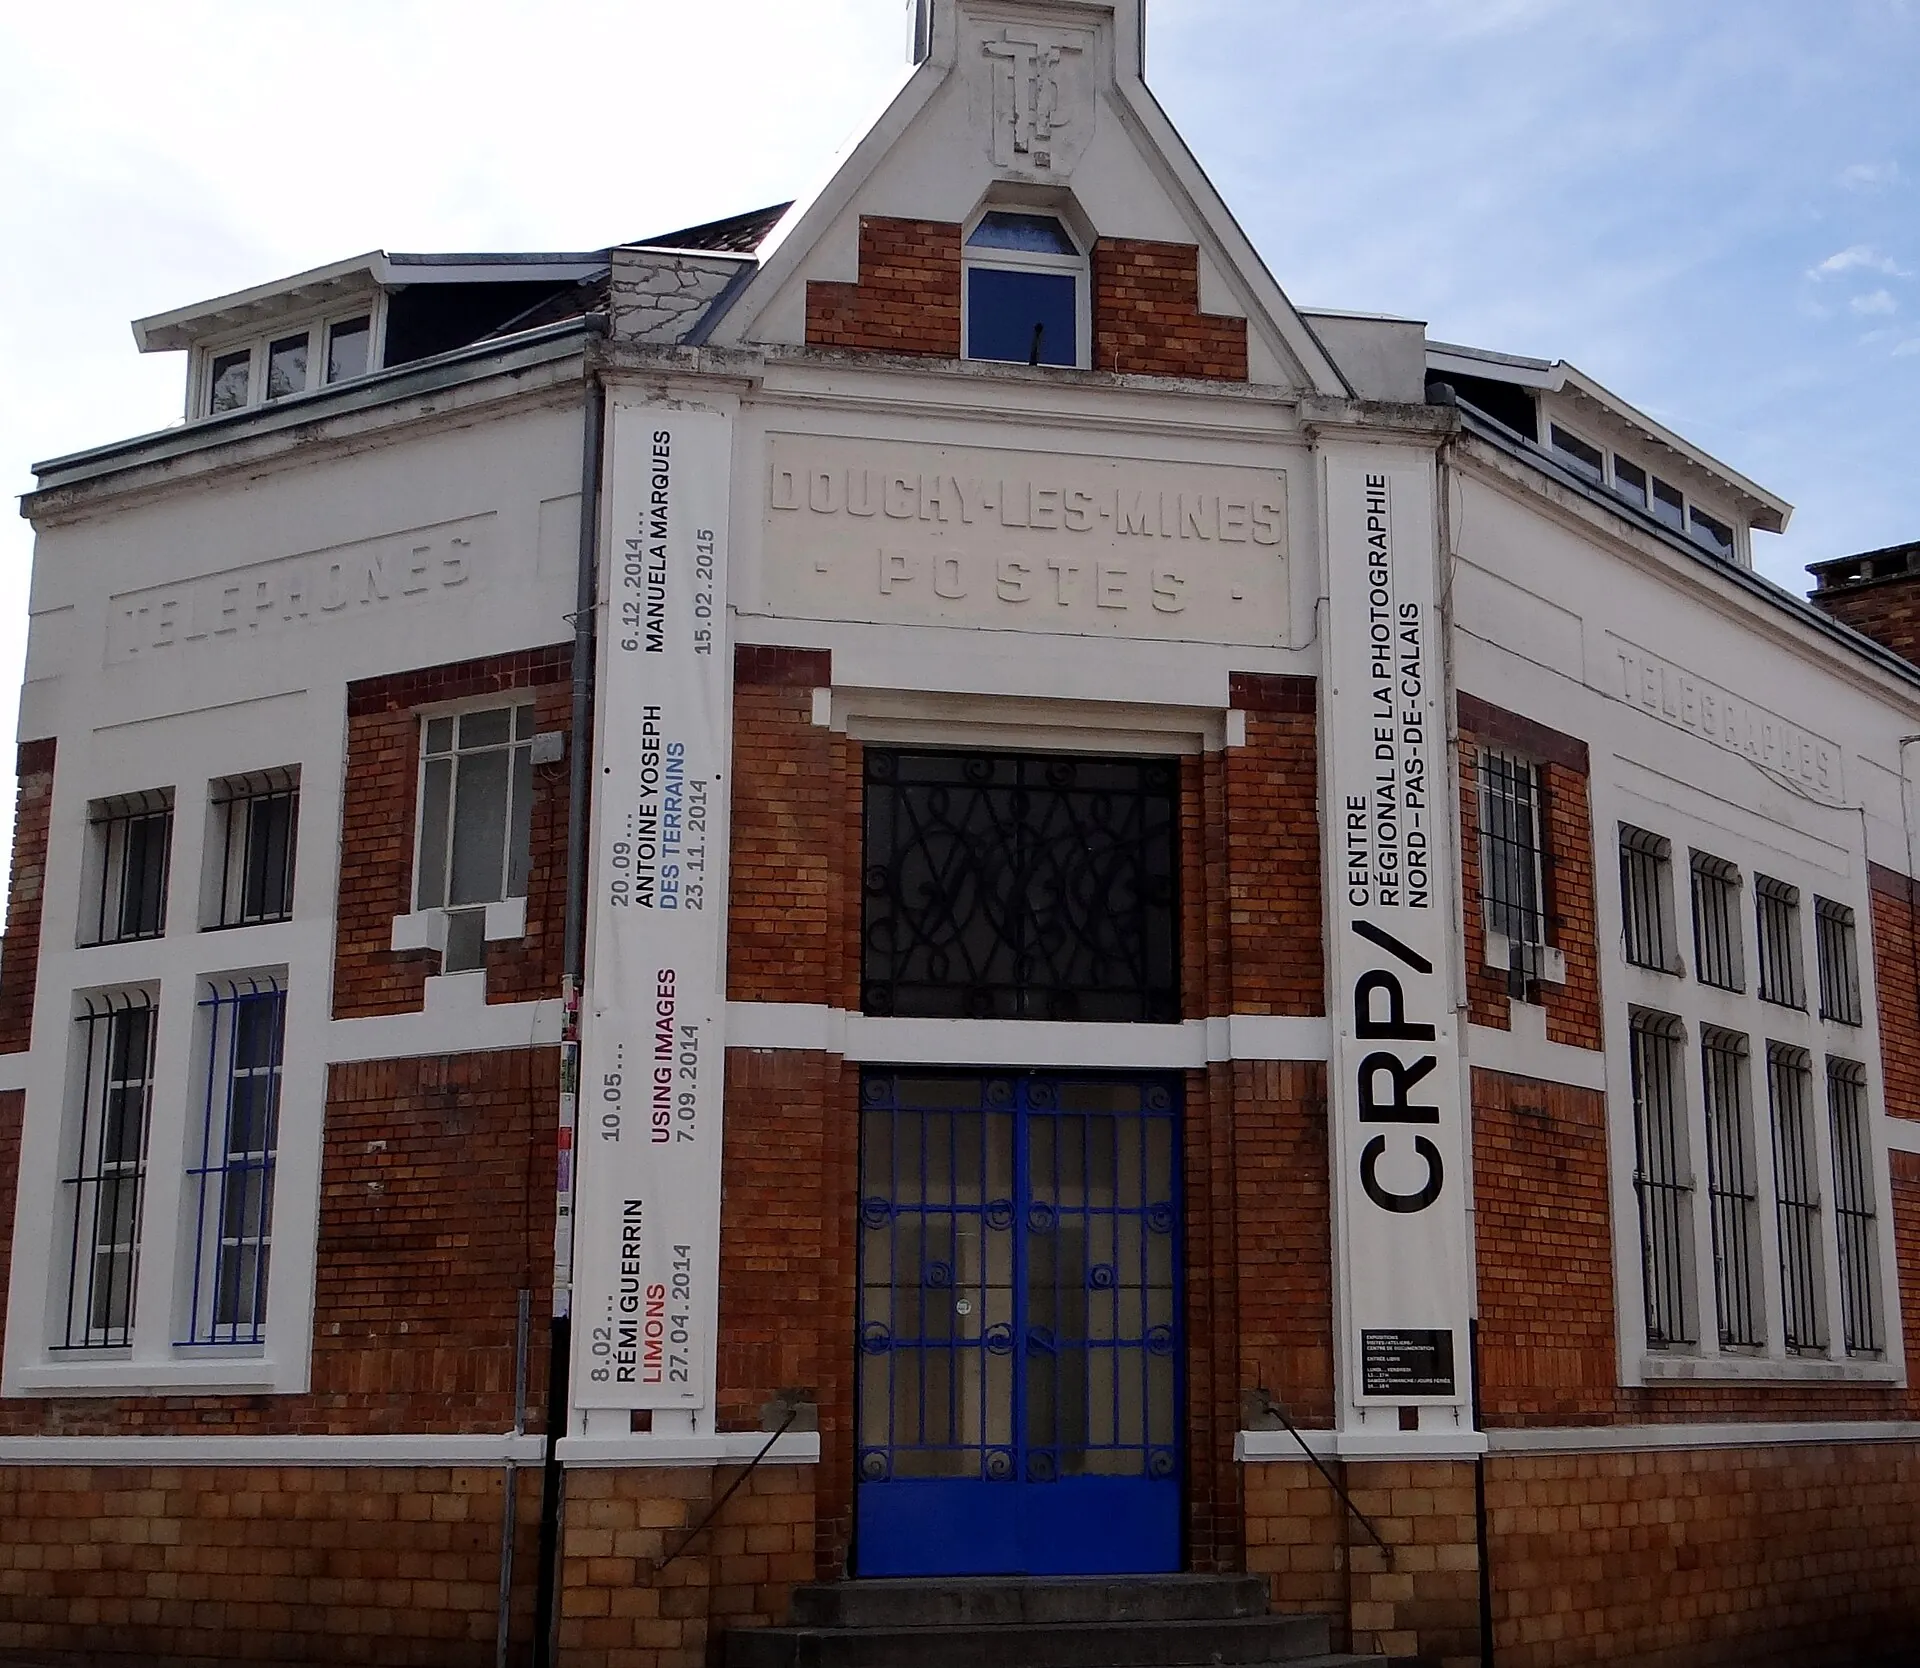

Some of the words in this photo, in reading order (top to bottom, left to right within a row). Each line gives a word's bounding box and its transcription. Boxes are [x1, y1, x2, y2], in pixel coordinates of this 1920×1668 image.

[650, 430, 671, 539] MARQUES
[124, 534, 472, 653] TELEPHONES
[646, 544, 667, 653] MANUELA
[694, 529, 714, 655] 15.02.2015
[879, 548, 1185, 614] POSTES
[1366, 474, 1392, 679] PHOTOGRAPHIE
[640, 705, 661, 798] YOSEPH
[1372, 686, 1393, 719] LA
[1374, 728, 1394, 761] DE
[1616, 650, 1831, 789] TELEGRAPHES
[662, 742, 684, 858] TERRAINS
[685, 779, 707, 910] 23.11.2014
[1346, 795, 1369, 907] CENTRE
[1373, 768, 1399, 907] RÉGIONAL
[636, 804, 657, 908] ANTOINE
[660, 864, 680, 910] DES
[655, 968, 676, 1061] IMAGES
[651, 1067, 672, 1143] USING
[677, 1025, 699, 1142] 7.09.2014
[620, 1199, 643, 1313] GUERRIN
[613, 1320, 638, 1383] RÉMI
[643, 1284, 665, 1383] LIMONS
[669, 1245, 691, 1382] 27.04.2014
